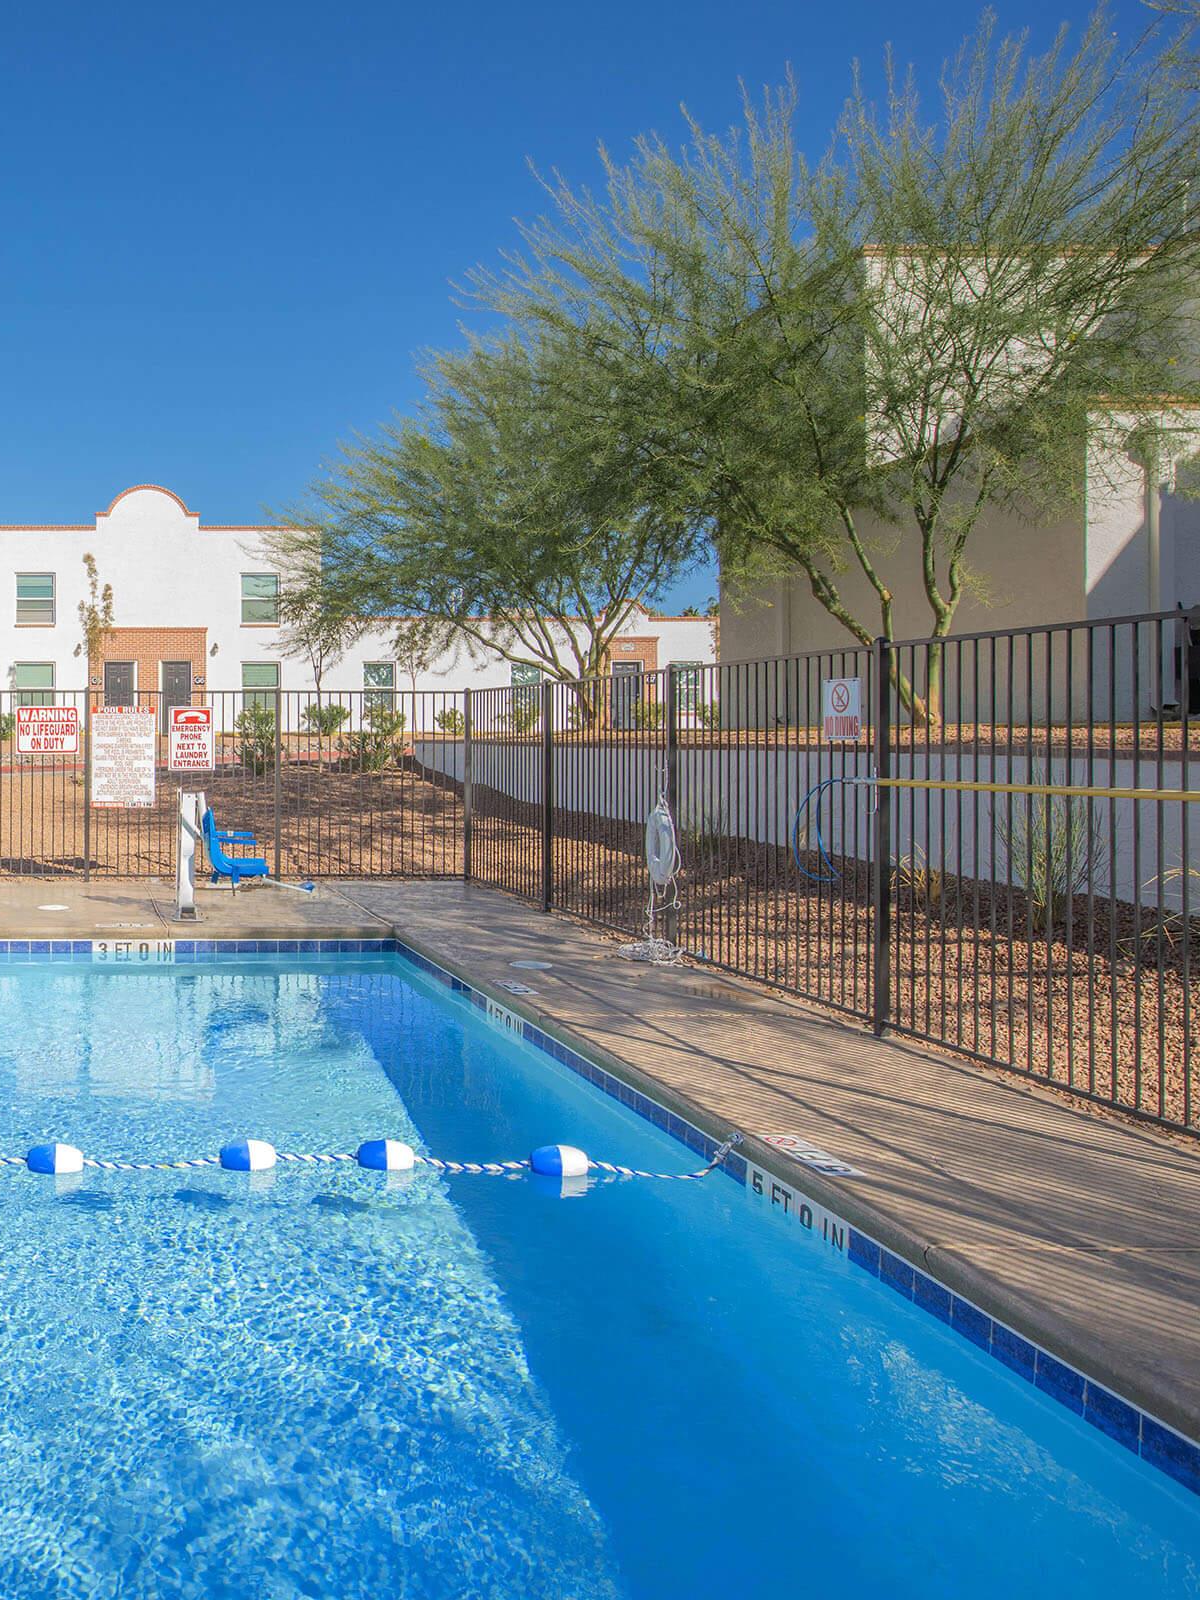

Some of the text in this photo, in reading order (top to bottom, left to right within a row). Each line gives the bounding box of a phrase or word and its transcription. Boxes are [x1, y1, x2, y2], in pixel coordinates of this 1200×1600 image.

[19, 709, 77, 721] WARNING
[97, 706, 151, 714] POOL RULES
[20, 724, 75, 736] NO LIFEGUARD
[824, 716, 859, 737] NO DIVING
[31, 738, 64, 750] ON DUTY
[175, 751, 208, 759] LAUNDRY
[752, 1170, 763, 1195] 5
[771, 1182, 792, 1214] FT
[823, 1217, 844, 1252] IN
